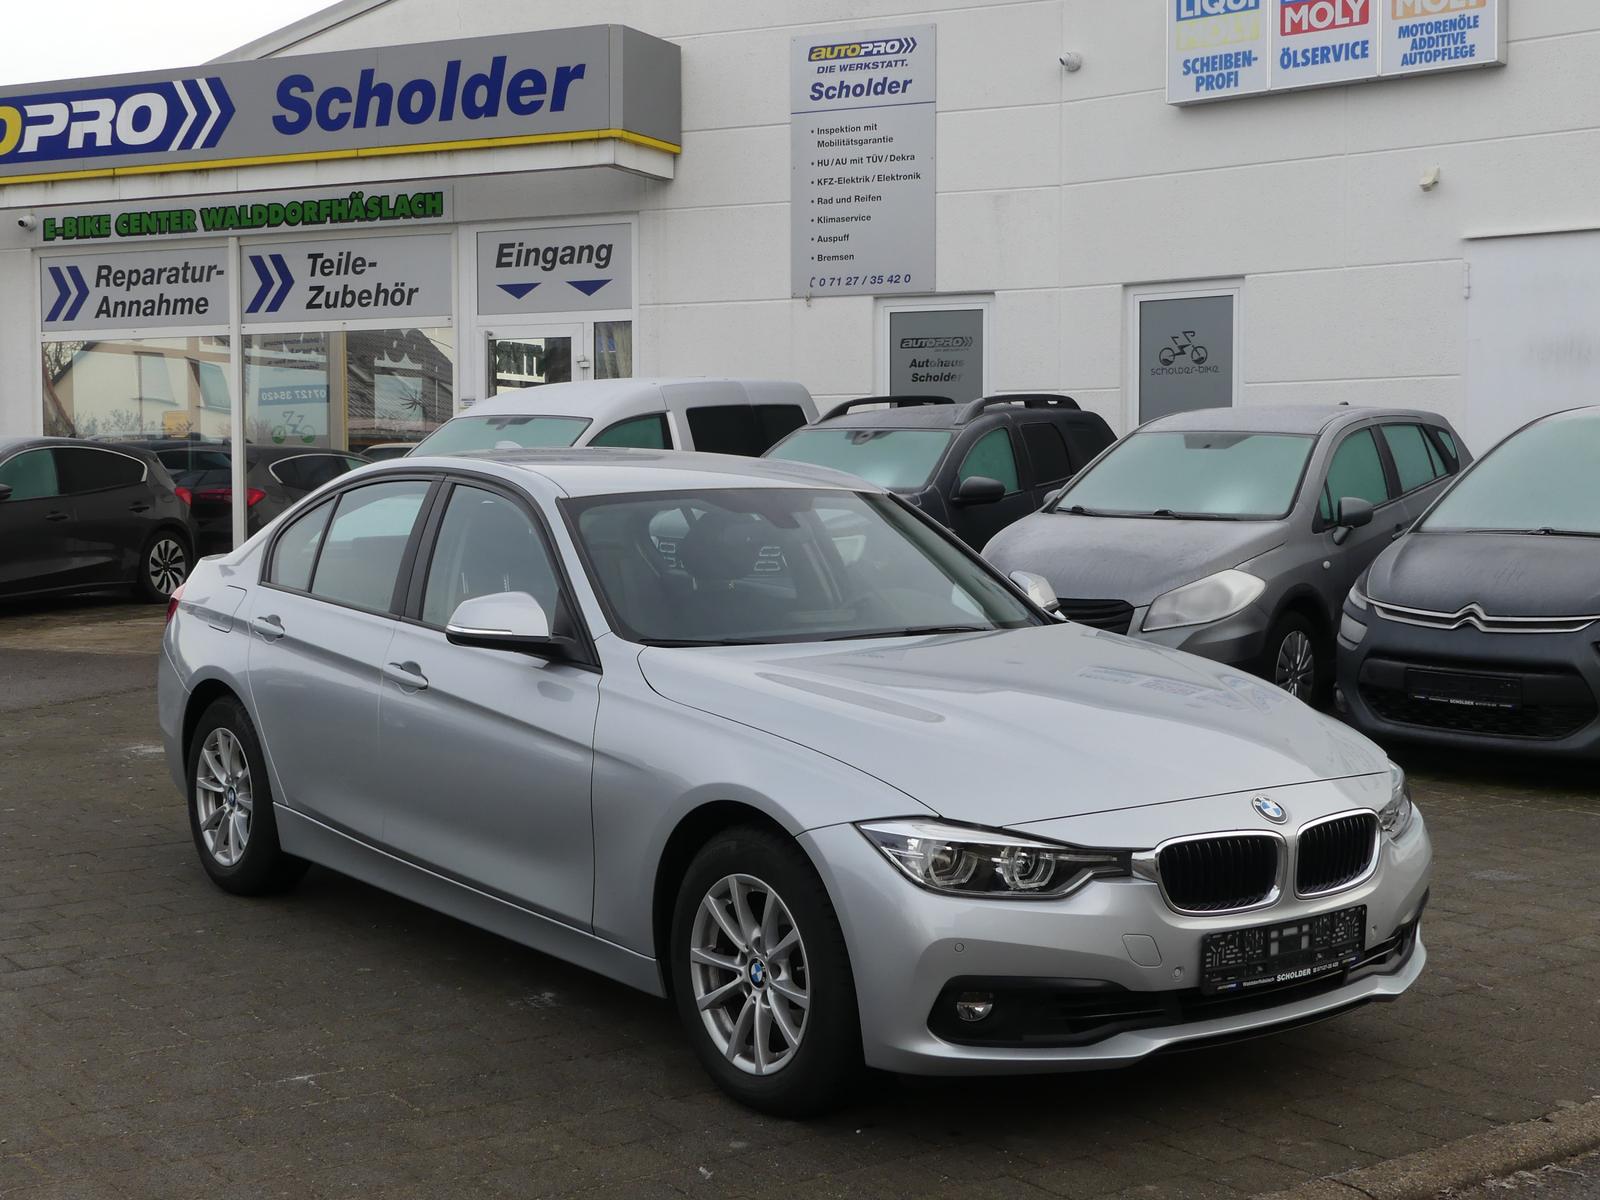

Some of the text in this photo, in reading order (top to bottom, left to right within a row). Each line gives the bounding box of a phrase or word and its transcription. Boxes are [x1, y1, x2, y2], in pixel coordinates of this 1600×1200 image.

[1284, 0, 1367, 33] MOLY
[1397, 14, 1480, 39] MOTORENÖLE
[1410, 31, 1466, 51] ADDITIVE
[1182, 50, 1258, 76] SCHEIBEN-
[1279, 40, 1370, 70] ÖLSERVICE
[1400, 44, 1475, 66] AUTOPFLEGE
[817, 59, 908, 74] DIE WERKSTATT.
[809, 77, 913, 101] Scholder
[1195, 71, 1239, 92] PROFI
[272, 55, 586, 135] Scholder
[817, 123, 877, 135] Inspektion mit
[817, 136, 894, 148] Mobilitätsgarantie
[849, 157, 864, 165] mit
[817, 194, 882, 205] Rad und Reifen
[43, 190, 444, 241] E-BIKE CENTER WALDDORFHÄSLACH
[817, 214, 872, 224] Klimaservice
[817, 234, 850, 244] Auspuff
[307, 251, 378, 277] Teile-
[495, 241, 614, 272] Eingang
[817, 254, 855, 262] Bremsen
[95, 261, 225, 291] Reparatur-
[818, 277, 826, 287] 0
[829, 277, 842, 287] 71
[845, 276, 860, 286] 27
[870, 275, 884, 285] 35
[887, 274, 901, 284] 42
[904, 273, 912, 283] 0
[94, 293, 209, 319] Annahme
[305, 282, 419, 310] Zubehör
[1276, 968, 1312, 982] SCHOLDER
